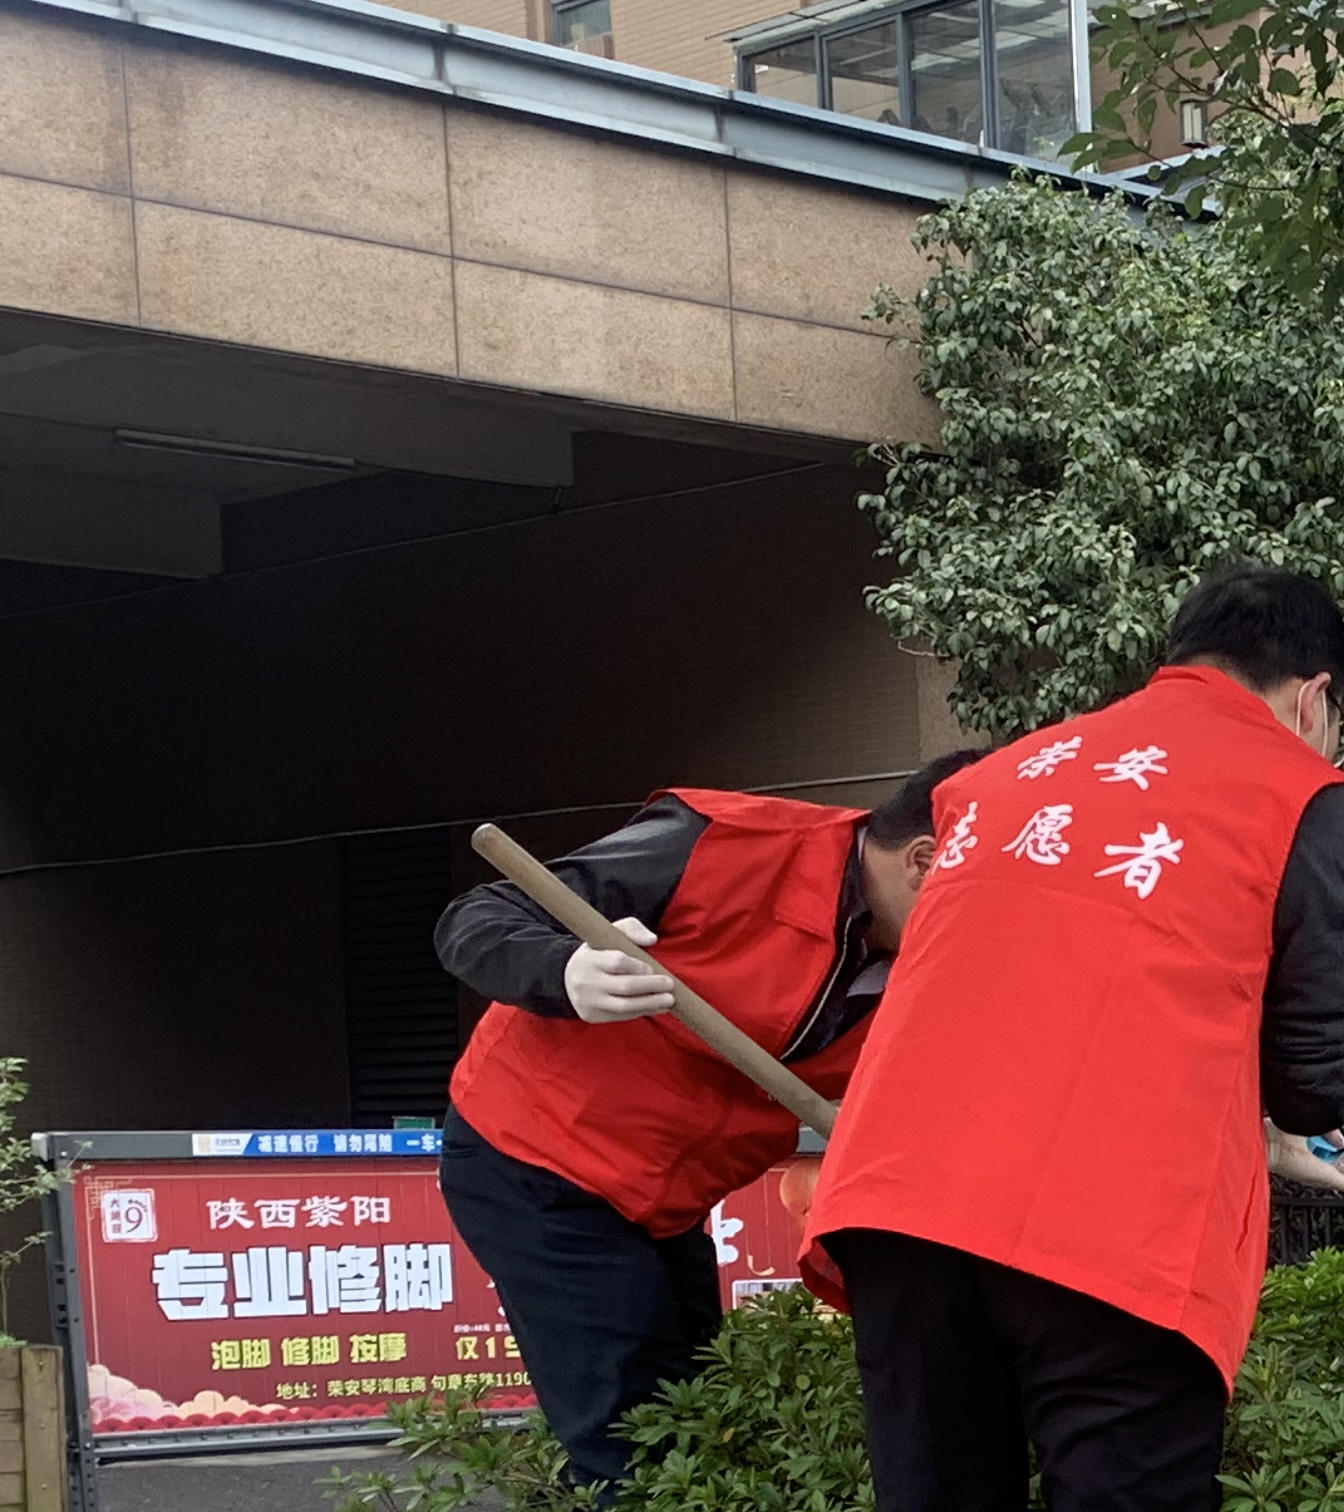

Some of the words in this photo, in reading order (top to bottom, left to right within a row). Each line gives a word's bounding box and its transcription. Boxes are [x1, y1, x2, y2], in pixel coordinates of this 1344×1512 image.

[1017, 736, 1169, 790] 荣安
[931, 801, 1184, 900] 志愿者
[206, 1196, 391, 1230] 陕西紫阳
[152, 1243, 453, 1321] 专业修脚
[211, 1338, 271, 1371] 泡脚
[281, 1335, 340, 1367] 修脚
[349, 1332, 408, 1364] 按摩
